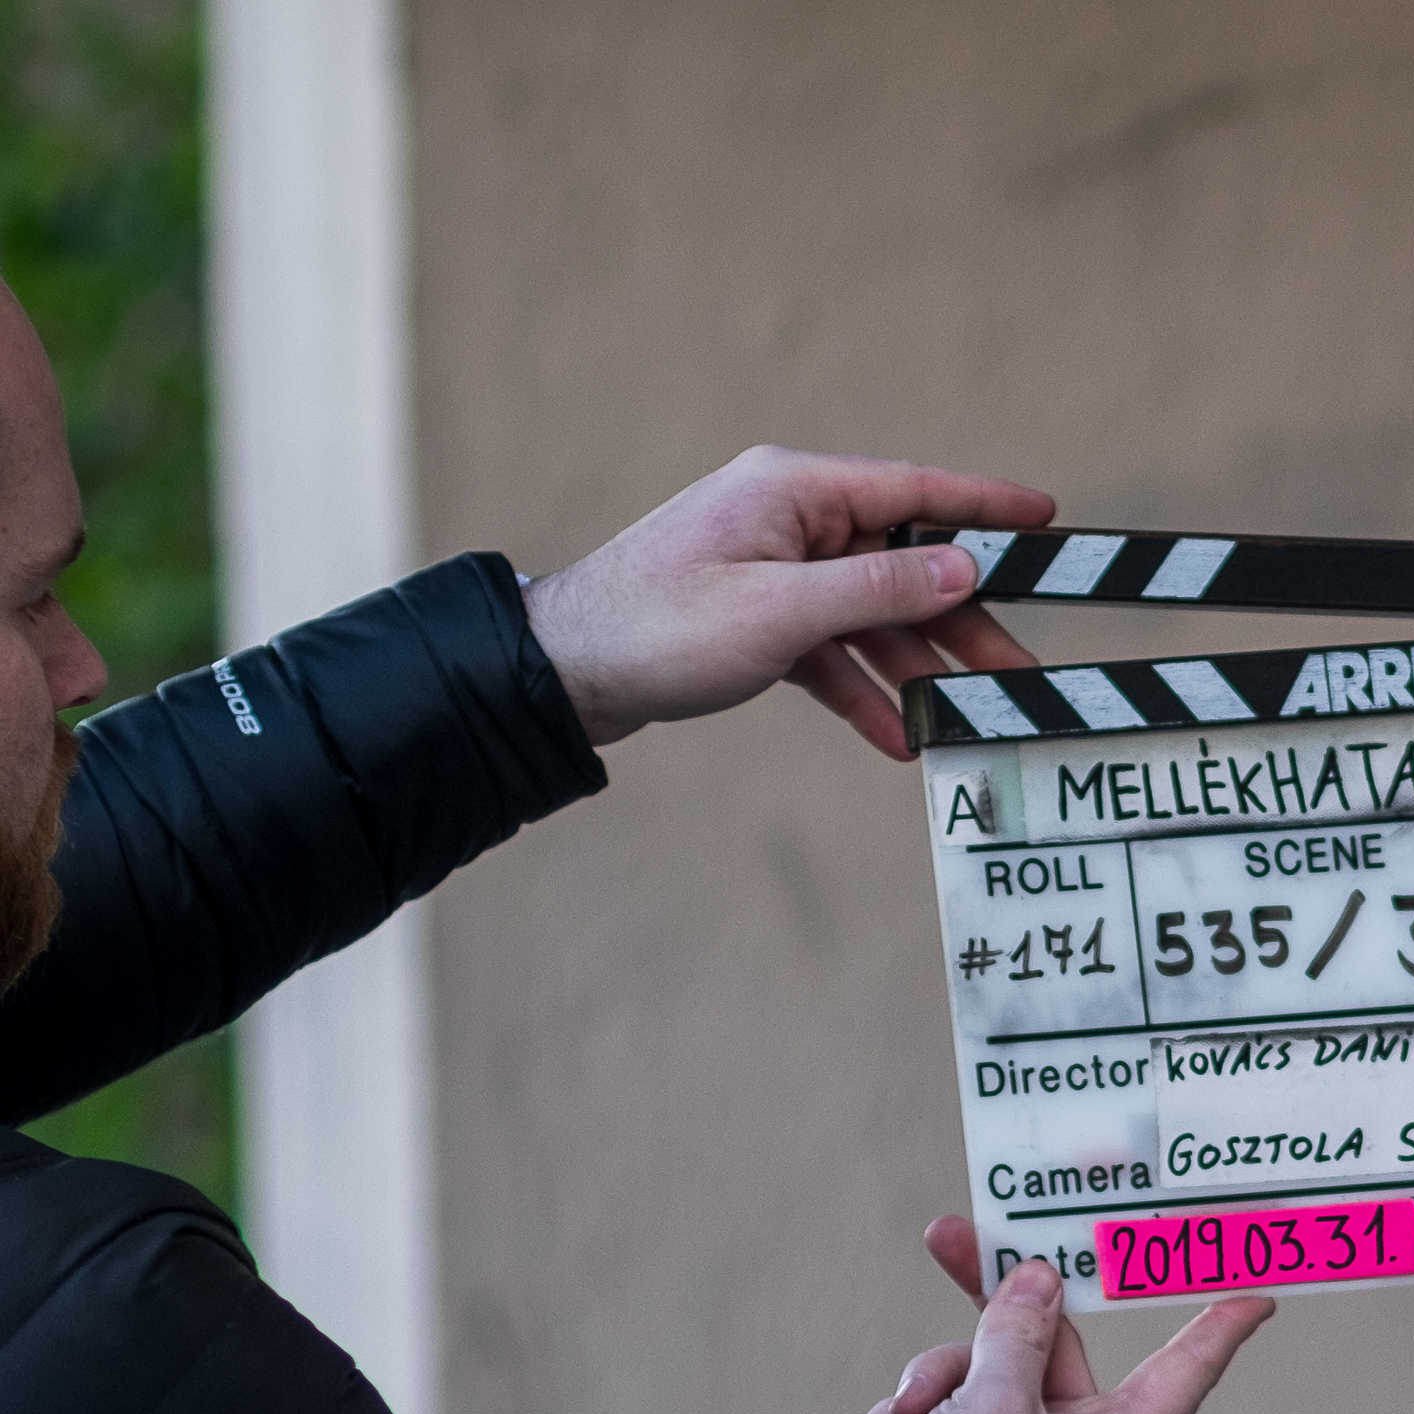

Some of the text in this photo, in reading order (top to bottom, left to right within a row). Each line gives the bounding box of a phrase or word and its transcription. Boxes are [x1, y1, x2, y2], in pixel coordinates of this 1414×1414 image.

[945, 784, 990, 836] A
[985, 854, 1104, 898] ROLL
[1244, 833, 1386, 878] SCENE
[958, 916, 1116, 981] #171
[975, 1054, 1150, 1098] Director
[1168, 1127, 1364, 1177] GOSZTOLA
[987, 1161, 1153, 1200] Camera
[994, 1245, 1097, 1283] Dte
[1111, 1204, 1399, 1293] 2019.03.31.
